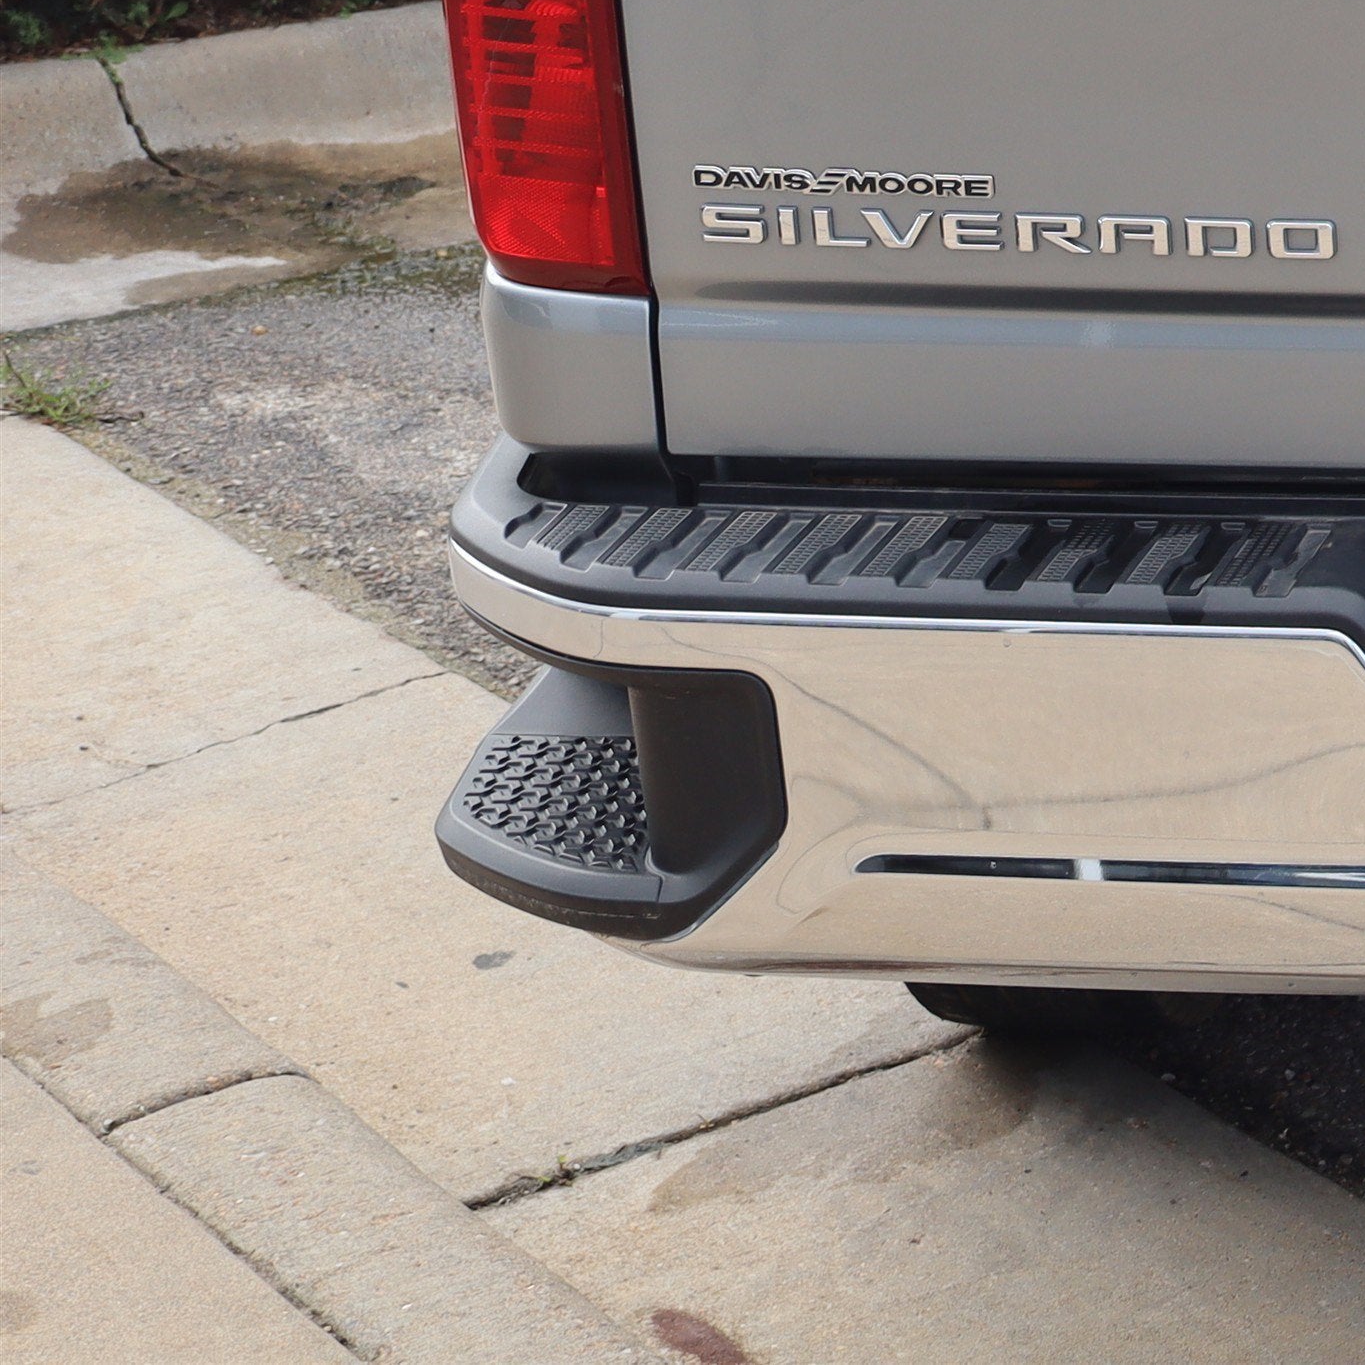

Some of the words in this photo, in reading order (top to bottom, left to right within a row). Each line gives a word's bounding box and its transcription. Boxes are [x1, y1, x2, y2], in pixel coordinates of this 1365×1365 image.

[693, 165, 811, 192] DAVIS
[843, 173, 995, 198] MOORE
[699, 201, 1338, 260] SILVERADO
